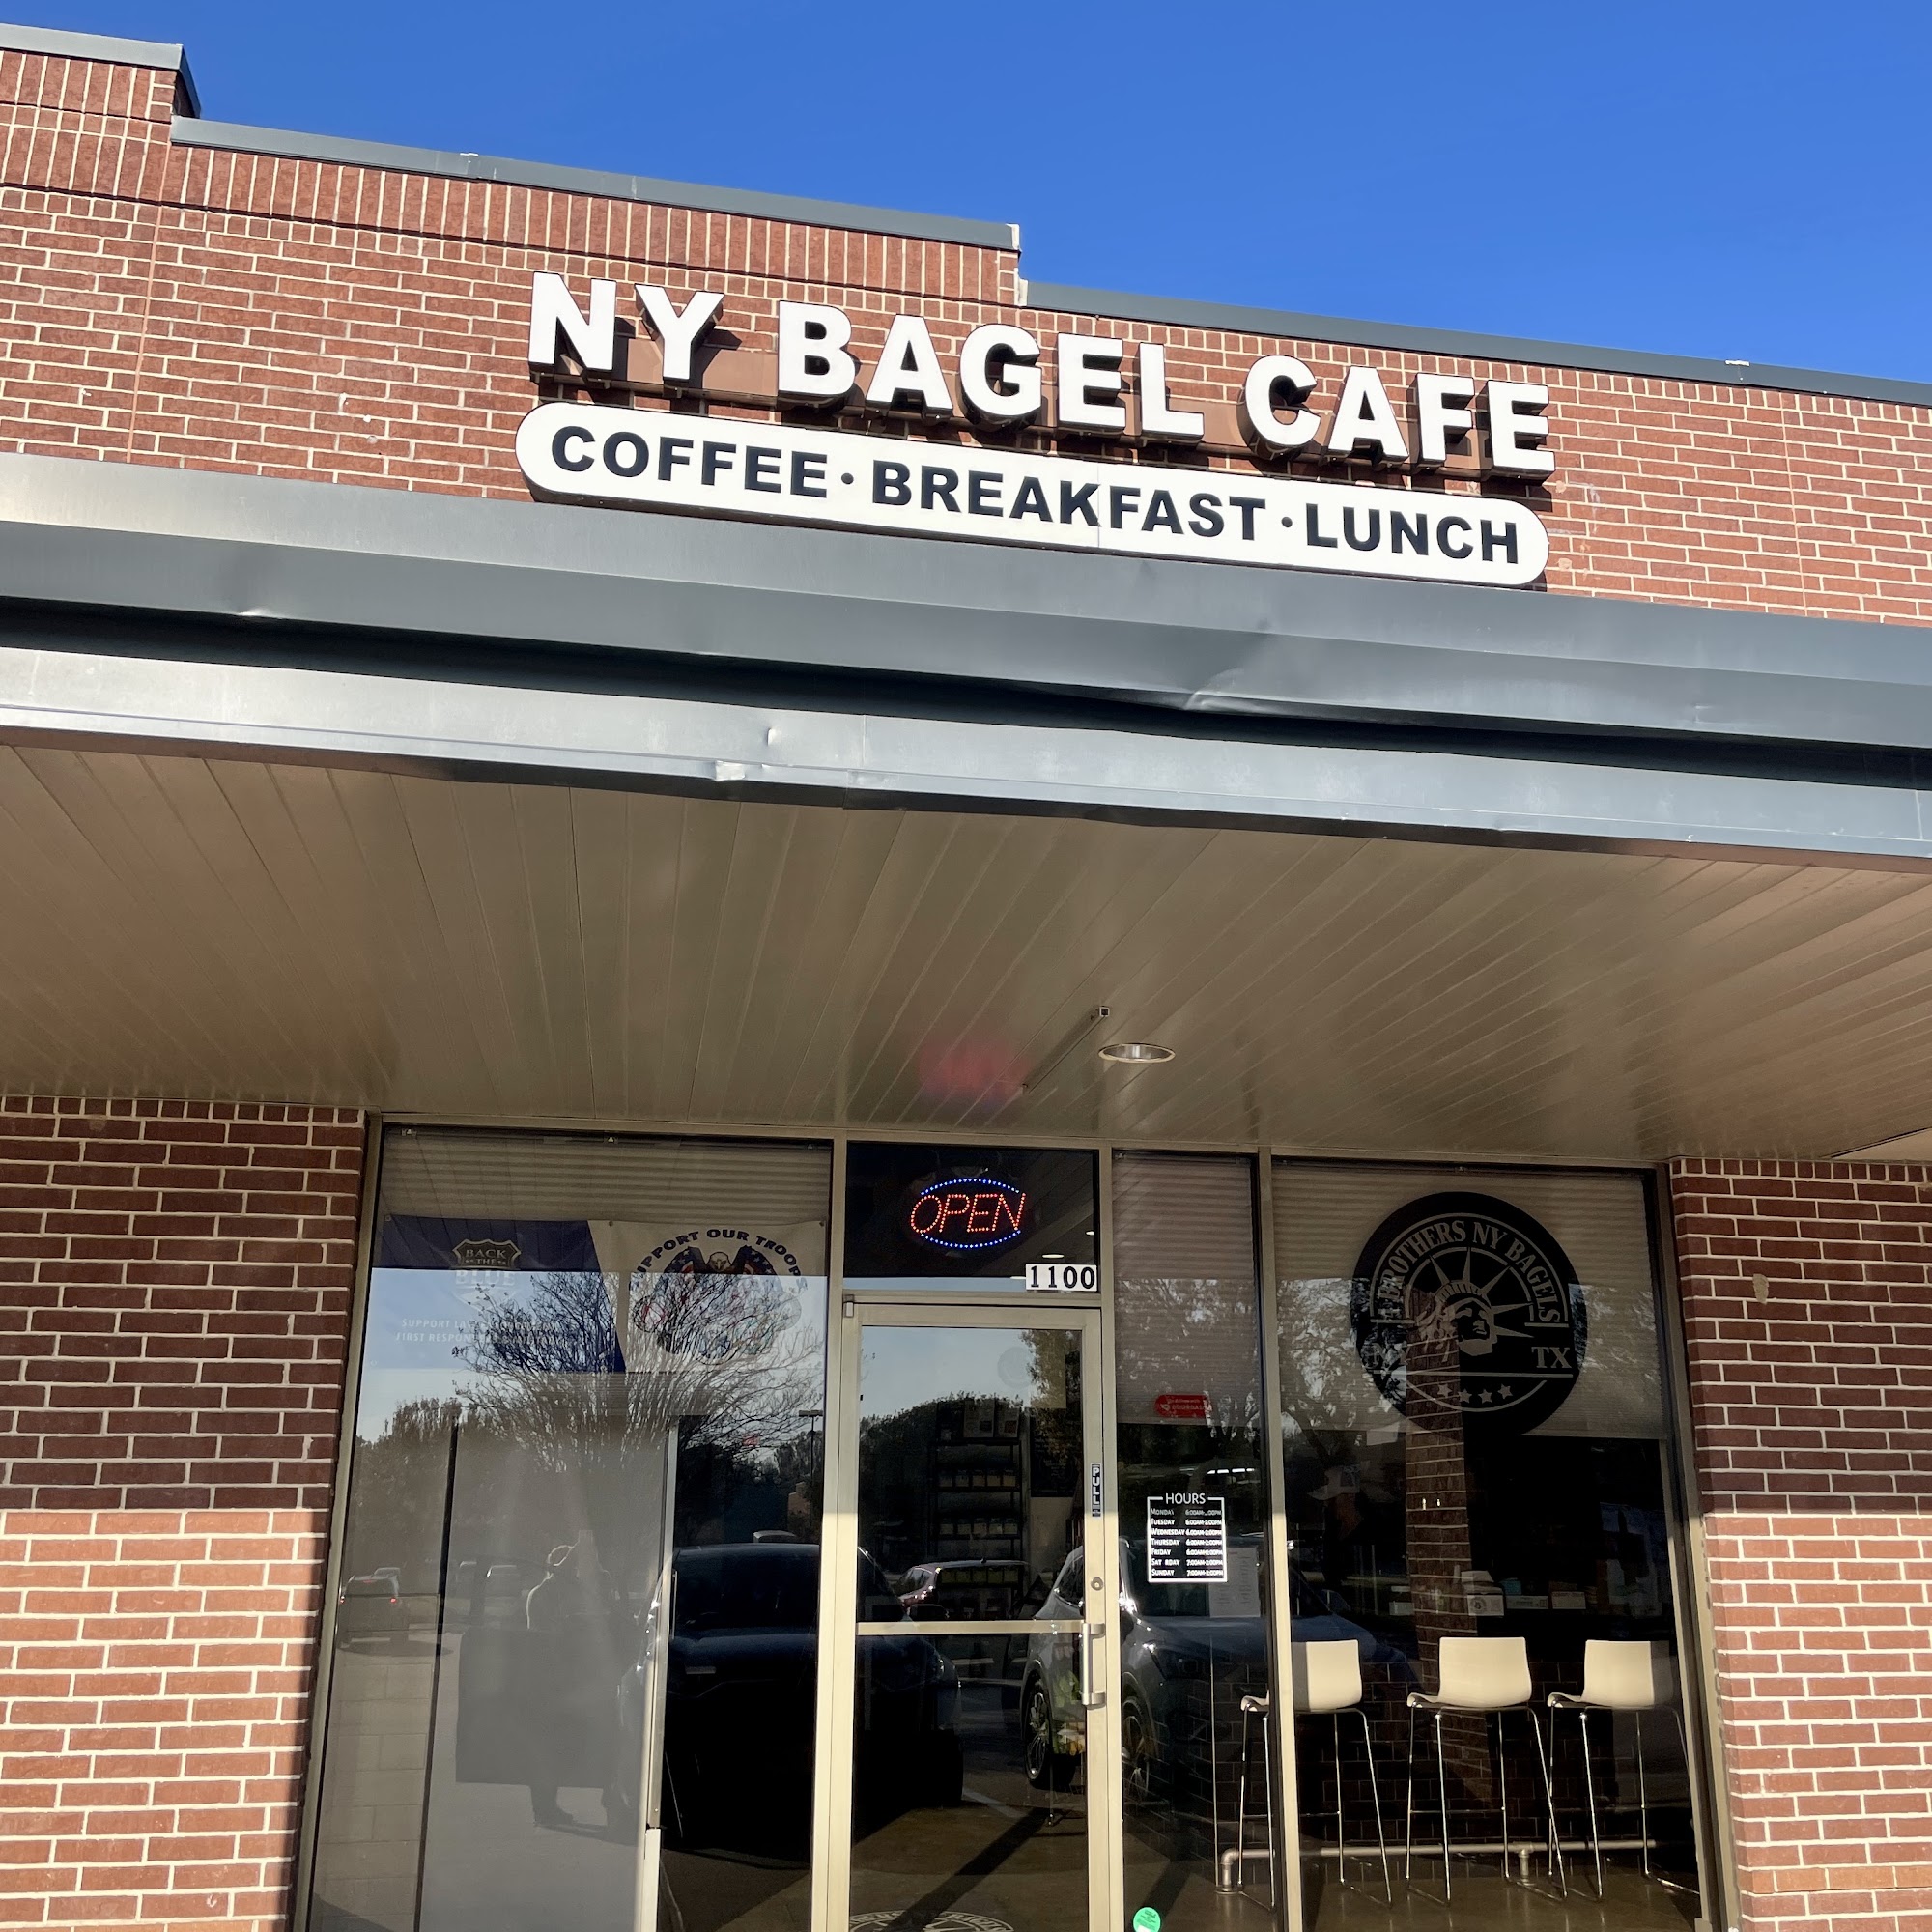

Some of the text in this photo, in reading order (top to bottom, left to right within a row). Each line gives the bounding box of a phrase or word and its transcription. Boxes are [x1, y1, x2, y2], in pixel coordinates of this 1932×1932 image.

[527, 271, 1556, 474] NY BAGEL CAFE
[551, 425, 1520, 564] COFFEE BREAKFAST LUNCH
[910, 1192, 1027, 1234] OPEN
[706, 1228, 750, 1243] OUR
[465, 1249, 507, 1259] BACK
[455, 1269, 515, 1286] BLUE
[1030, 1265, 1096, 1290] 1100
[1377, 1219, 1466, 1302] BROTHERS
[1472, 1221, 1509, 1250] NY
[1504, 1237, 1561, 1323] BAGELS
[402, 1318, 451, 1329] SUPPORT
[395, 1332, 425, 1343] FIRST
[1531, 1346, 1573, 1369] TX
[1092, 1467, 1100, 1505] PULL
[1165, 1492, 1207, 1505] HOURS
